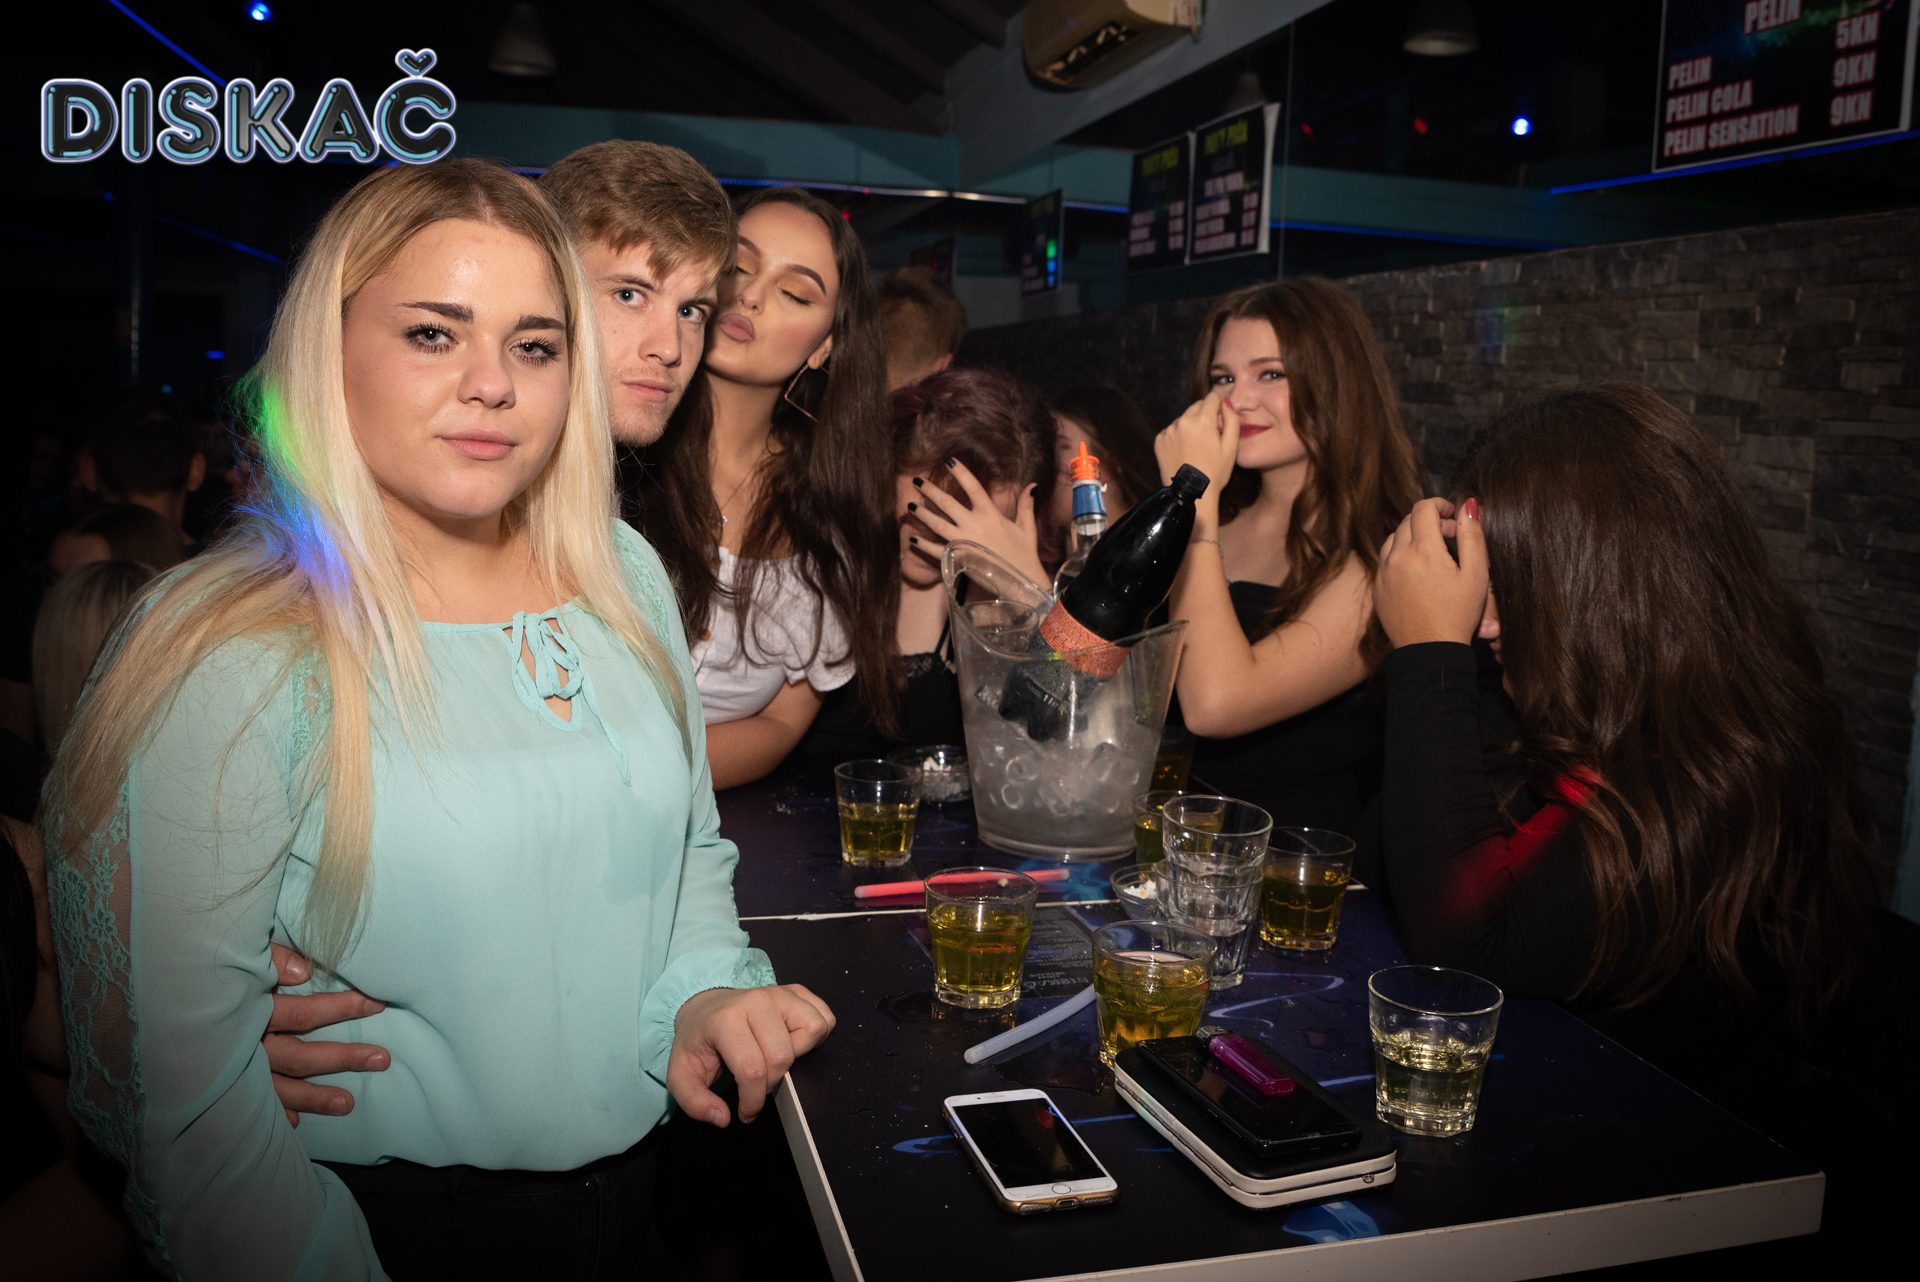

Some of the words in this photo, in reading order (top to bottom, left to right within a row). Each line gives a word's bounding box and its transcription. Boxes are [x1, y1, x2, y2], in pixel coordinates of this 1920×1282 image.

[1743, 0, 1803, 36] PELIN
[1834, 9, 1881, 50] 5KN
[1667, 54, 1713, 92] PELIN
[1832, 49, 1878, 88] 9KN
[1665, 89, 1710, 125] PELIN
[1710, 78, 1754, 115] COLA
[1829, 88, 1875, 127] 9KN
[1663, 123, 1707, 158] PELIN
[1707, 103, 1801, 149] SENSATION
